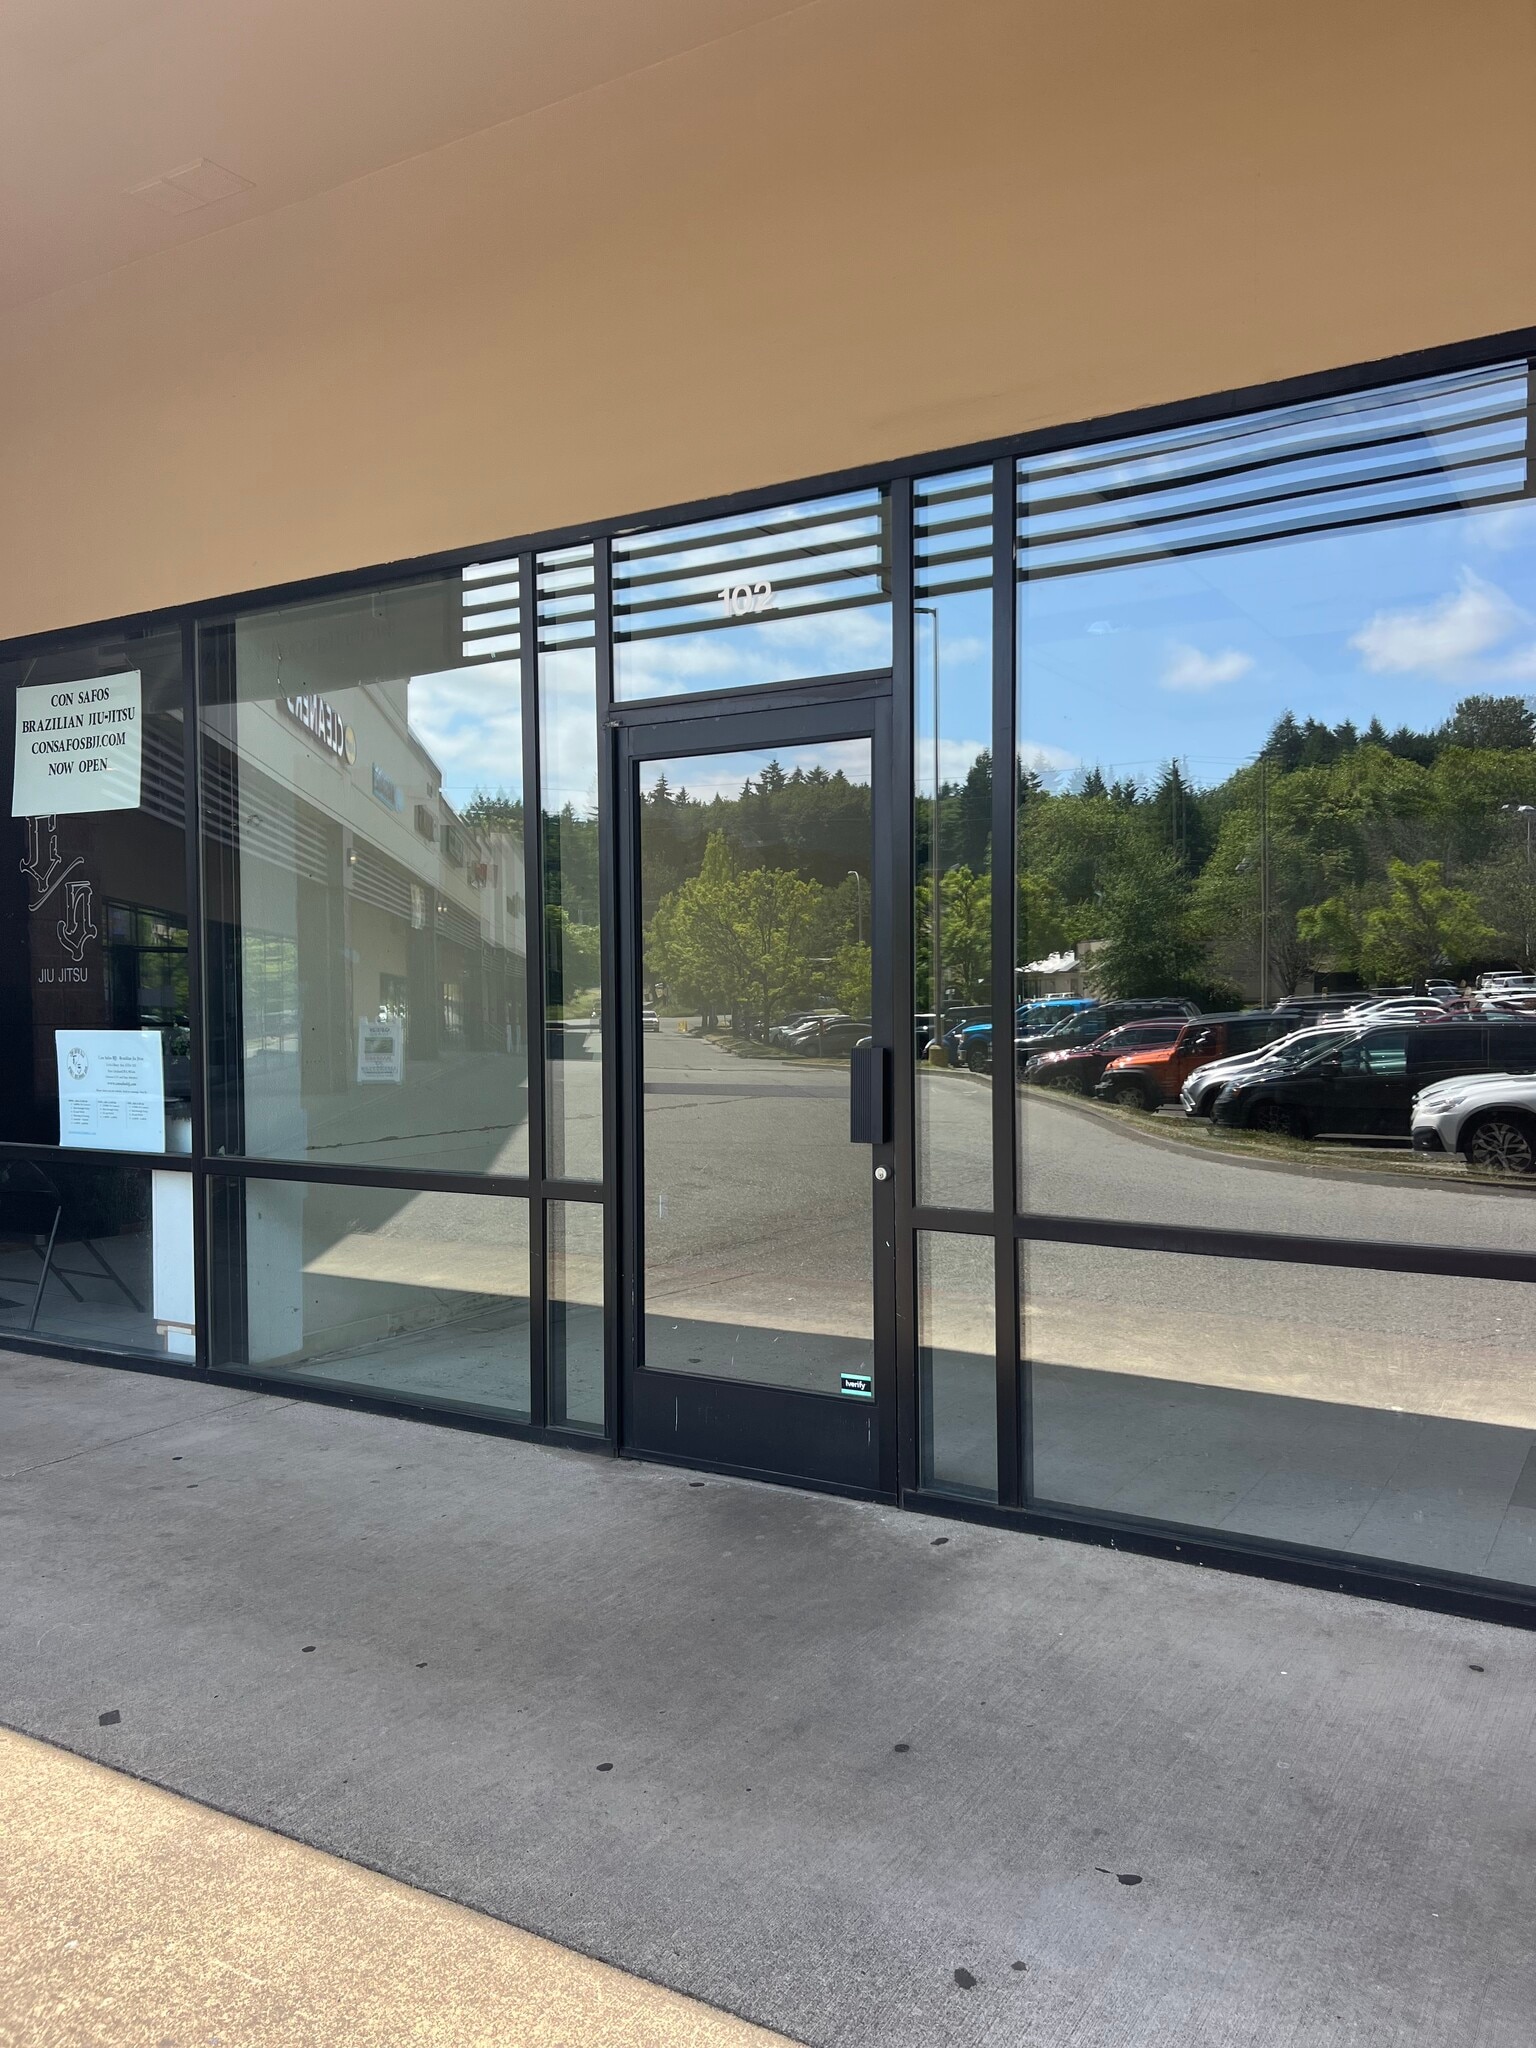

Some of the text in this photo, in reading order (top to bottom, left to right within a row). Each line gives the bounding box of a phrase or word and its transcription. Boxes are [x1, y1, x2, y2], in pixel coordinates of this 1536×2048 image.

[717, 581, 773, 616] 102
[51, 687, 110, 708] CON SAFOS
[22, 706, 136, 734] BRAZILIAN JIU-JITSU
[31, 731, 126, 755] CONSAFOSBJJ.COM
[48, 757, 109, 776] NOW OPEN
[38, 967, 88, 984] JIU JITSU
